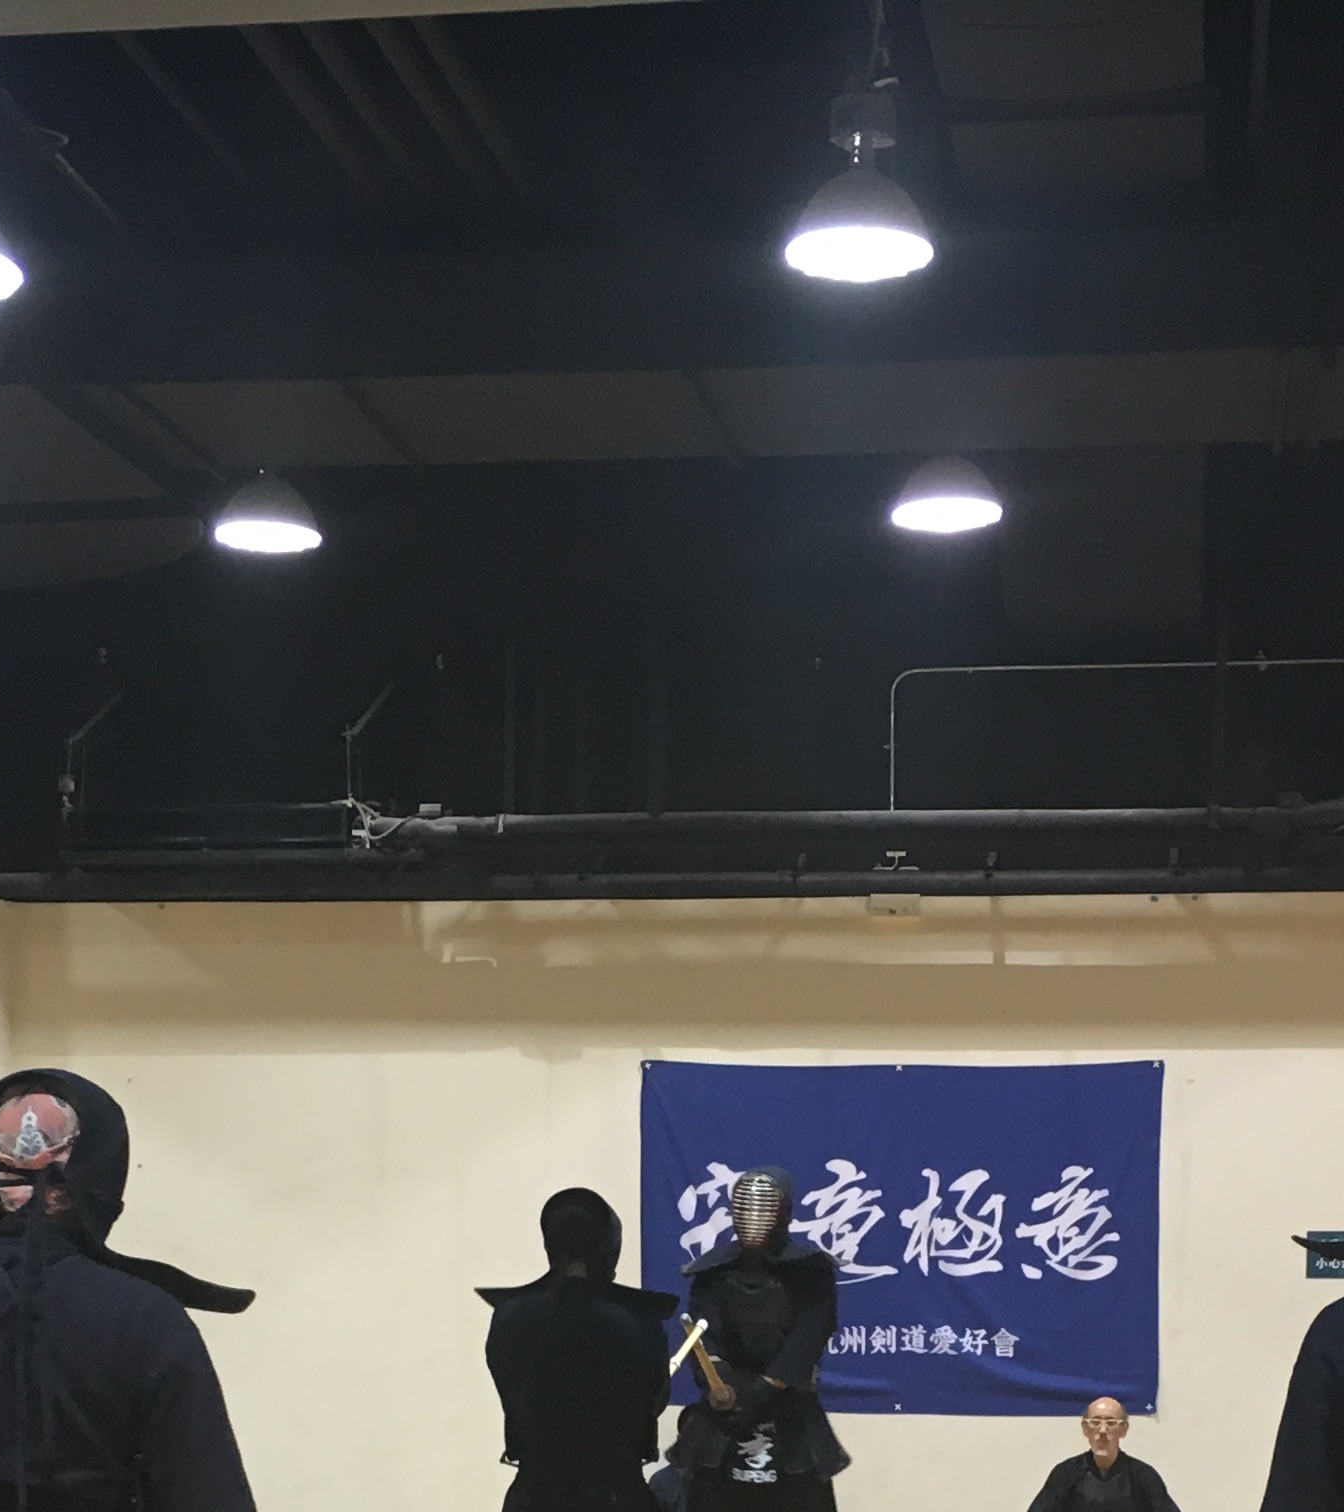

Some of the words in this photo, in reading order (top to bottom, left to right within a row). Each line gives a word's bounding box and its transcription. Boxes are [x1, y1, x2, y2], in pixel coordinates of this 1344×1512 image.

[827, 1324, 1021, 1358] 州剣道愛好會
